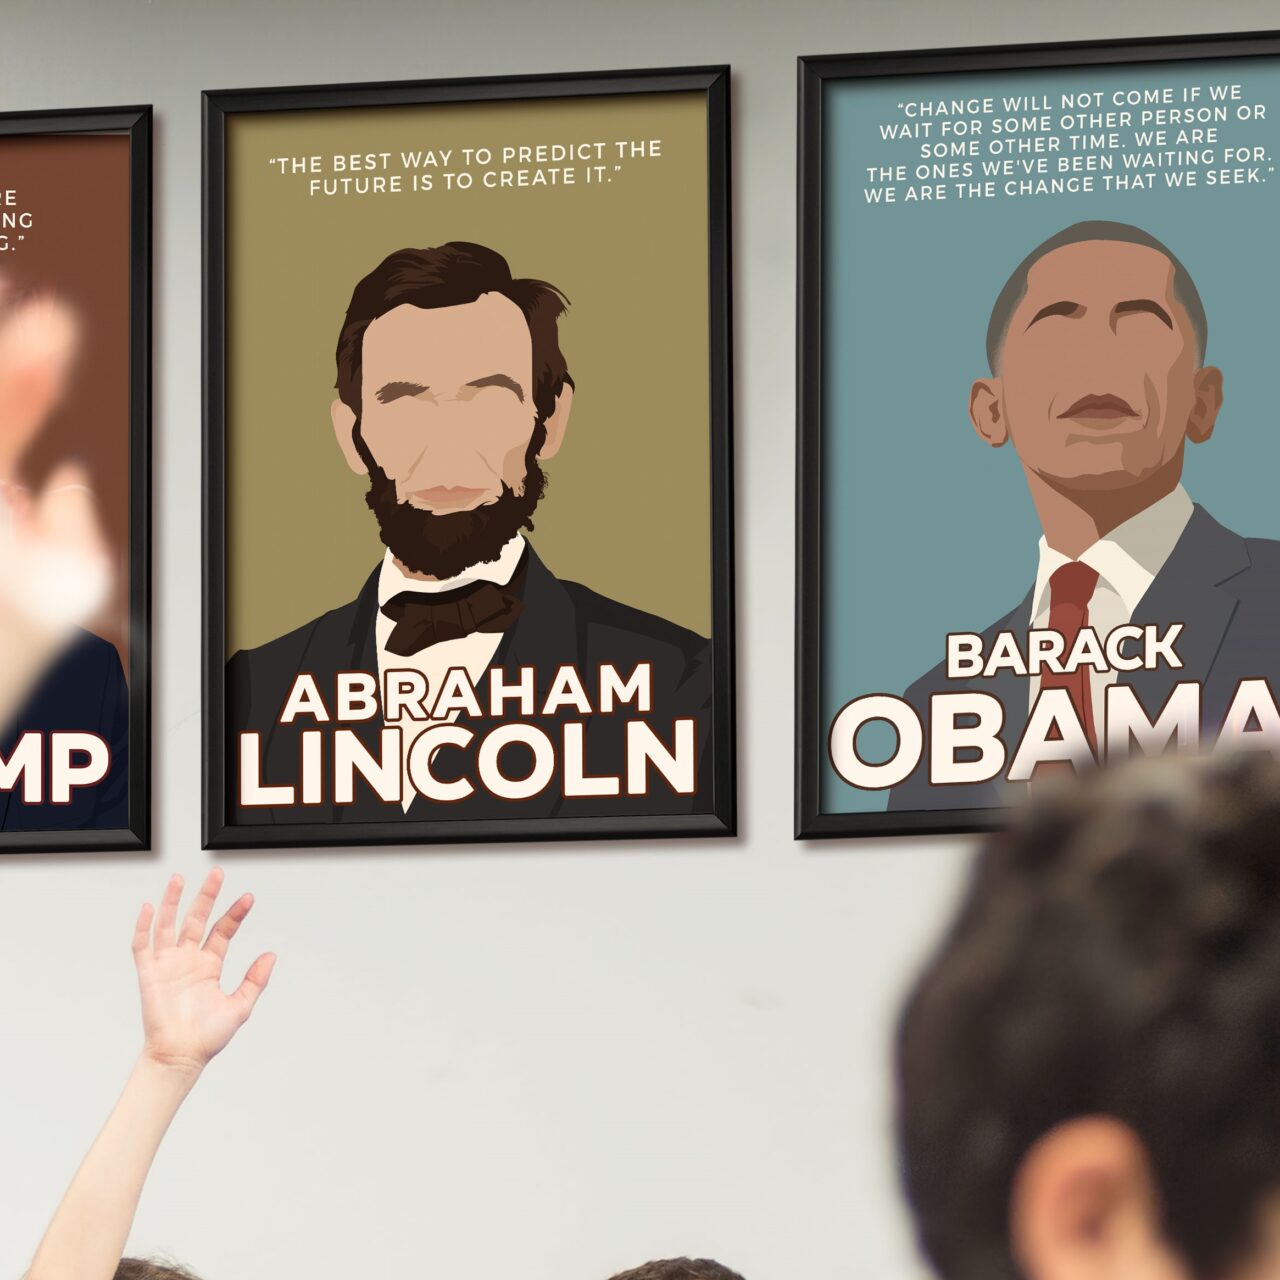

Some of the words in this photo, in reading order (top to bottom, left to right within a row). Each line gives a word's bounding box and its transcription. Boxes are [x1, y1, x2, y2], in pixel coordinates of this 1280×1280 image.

[1003, 96, 1051, 111] WILL
[1062, 93, 1103, 108] NOT
[1113, 89, 1173, 105] COME
[1184, 87, 1200, 102] IF
[1210, 85, 1241, 100] WE
[880, 123, 932, 139] WAIT
[942, 120, 981, 136] FOR
[992, 116, 1050, 133] SOME
[1061, 112, 1131, 129] OTHER
[1142, 107, 1226, 125] PERSON
[1237, 105, 1265, 120] OR
[334, 153, 390, 171] BEST
[401, 150, 452, 168] WAY
[462, 149, 491, 165] TO
[503, 143, 605, 163] PREDICT
[616, 140, 660, 158] THE
[921, 141, 979, 158] SOME
[990, 137, 1059, 154] OTHER
[1069, 134, 1125, 150] TIME.
[1135, 131, 1166, 146] WE
[1176, 128, 1217, 144] ARE
[867, 166, 906, 182] THE
[916, 163, 972, 179] ONES
[983, 159, 1047, 175] WE'VE
[1059, 155, 1112, 171] BEEN
[1123, 150, 1213, 168] WAITING
[1225, 147, 1271, 163] FOR.
[311, 176, 401, 195] FUTURE
[414, 175, 432, 191] IS
[443, 173, 472, 189] TO
[484, 168, 575, 187] CREATE
[864, 188, 895, 203] WE
[905, 185, 946, 201] ARE
[956, 182, 995, 198] THE
[1005, 177, 1093, 195] CHANGE
[1103, 174, 1156, 190] THAT
[1165, 172, 1196, 187] WE
[947, 624, 1184, 678] BARACK
[280, 663, 650, 722] ABRAHAM
[240, 720, 694, 805] LINCOLN
